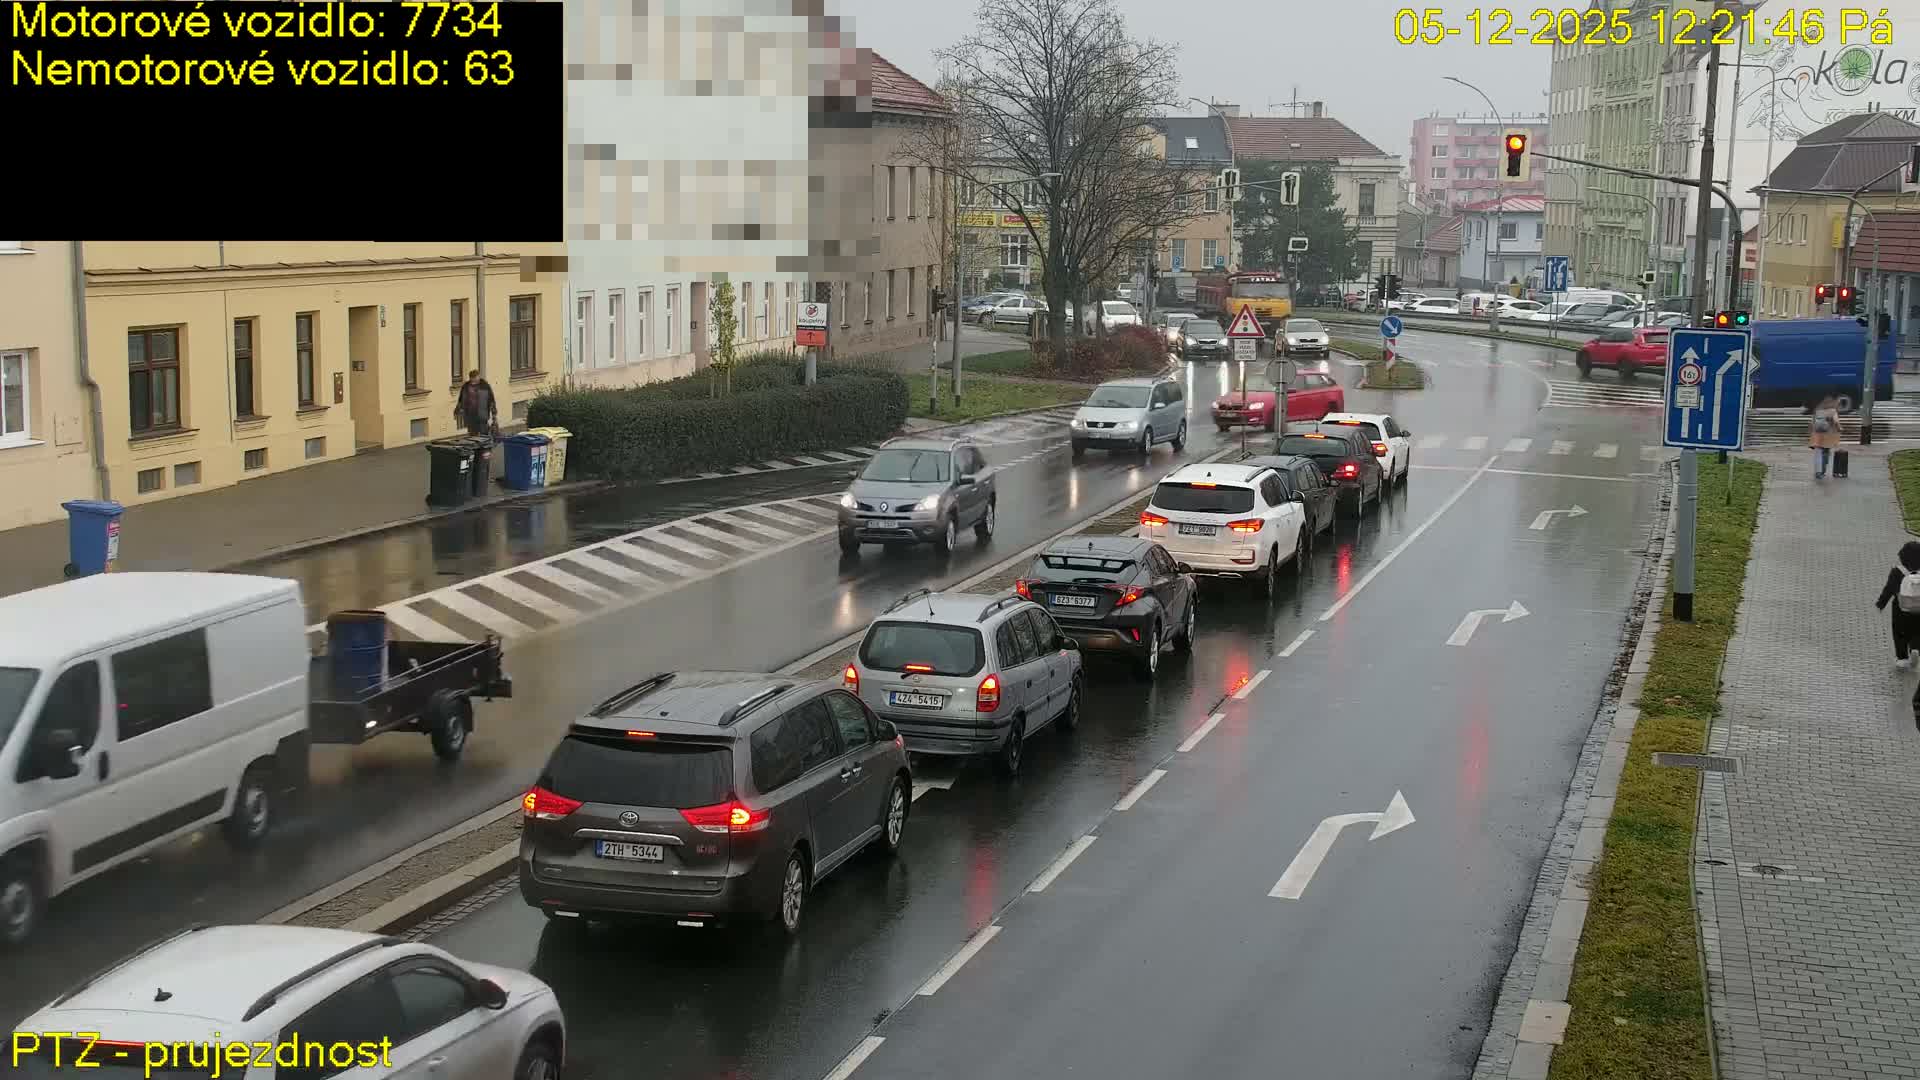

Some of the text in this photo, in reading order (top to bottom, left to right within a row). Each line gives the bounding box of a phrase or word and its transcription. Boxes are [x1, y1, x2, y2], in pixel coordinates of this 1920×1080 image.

[1056, 595, 1070, 604] 6Z3
[897, 694, 939, 705] 4Z4 5415
[604, 843, 658, 858] 2TH 5344
